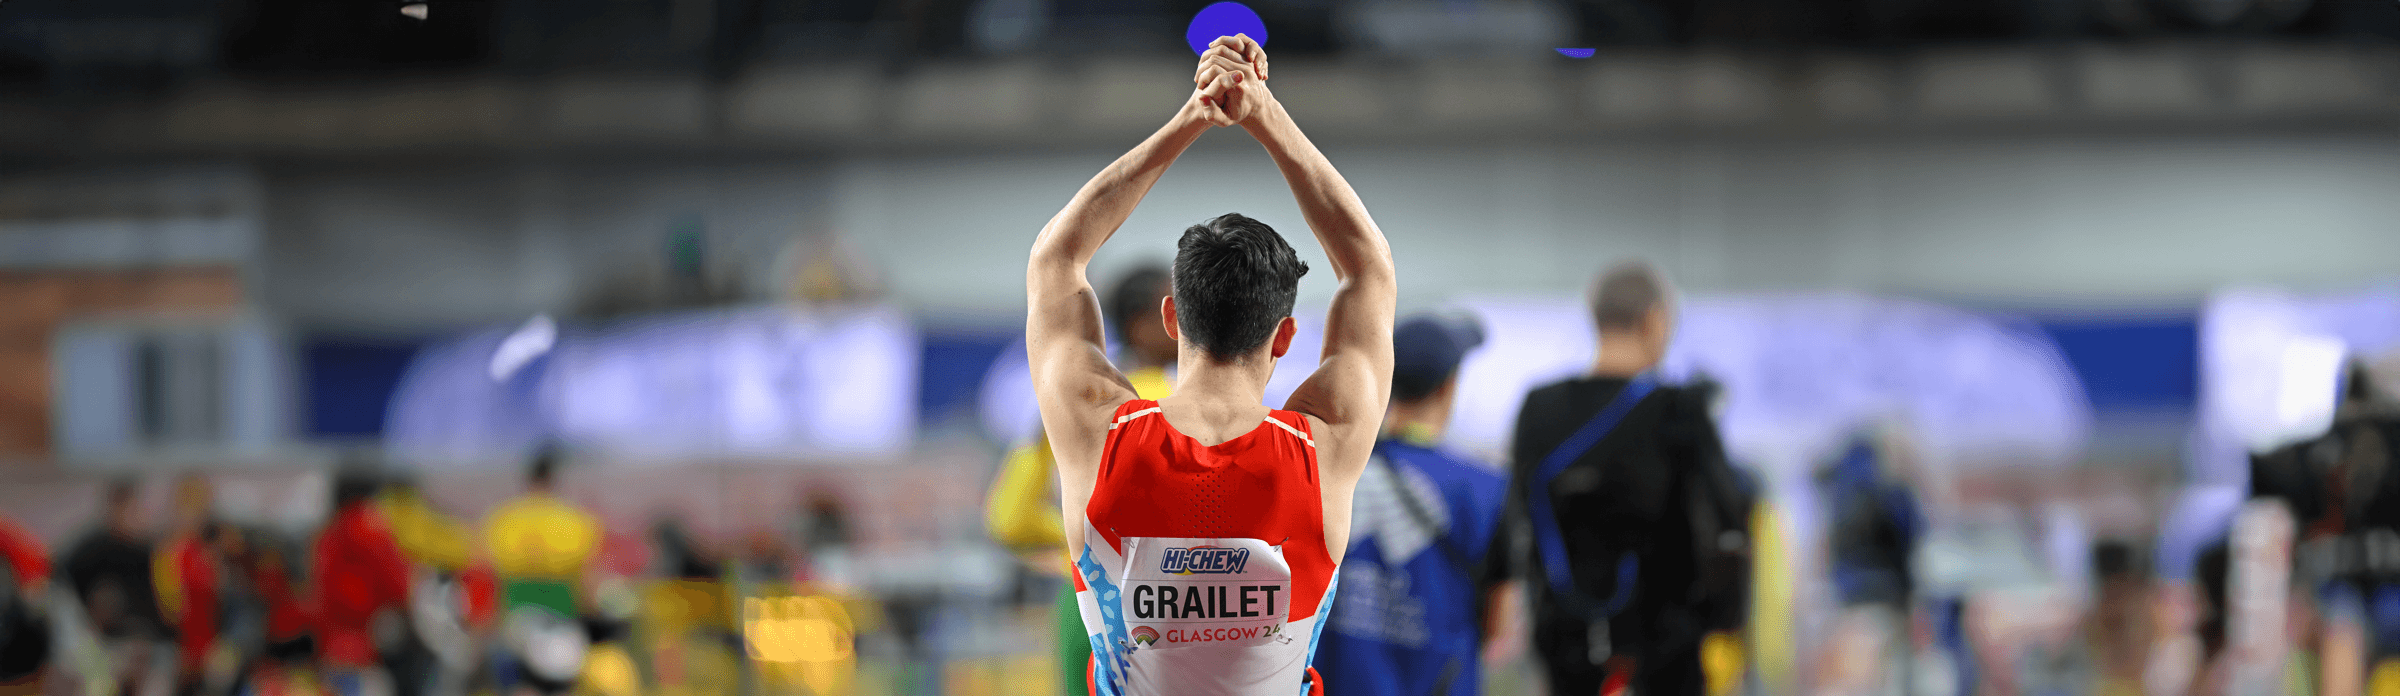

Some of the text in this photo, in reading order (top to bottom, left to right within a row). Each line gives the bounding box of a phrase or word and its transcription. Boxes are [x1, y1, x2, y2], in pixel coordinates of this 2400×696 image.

[1160, 547, 1249, 574] HI-CHEW
[1133, 585, 1280, 618] GRAILET
[1166, 624, 1281, 643] GLASGOW 24
